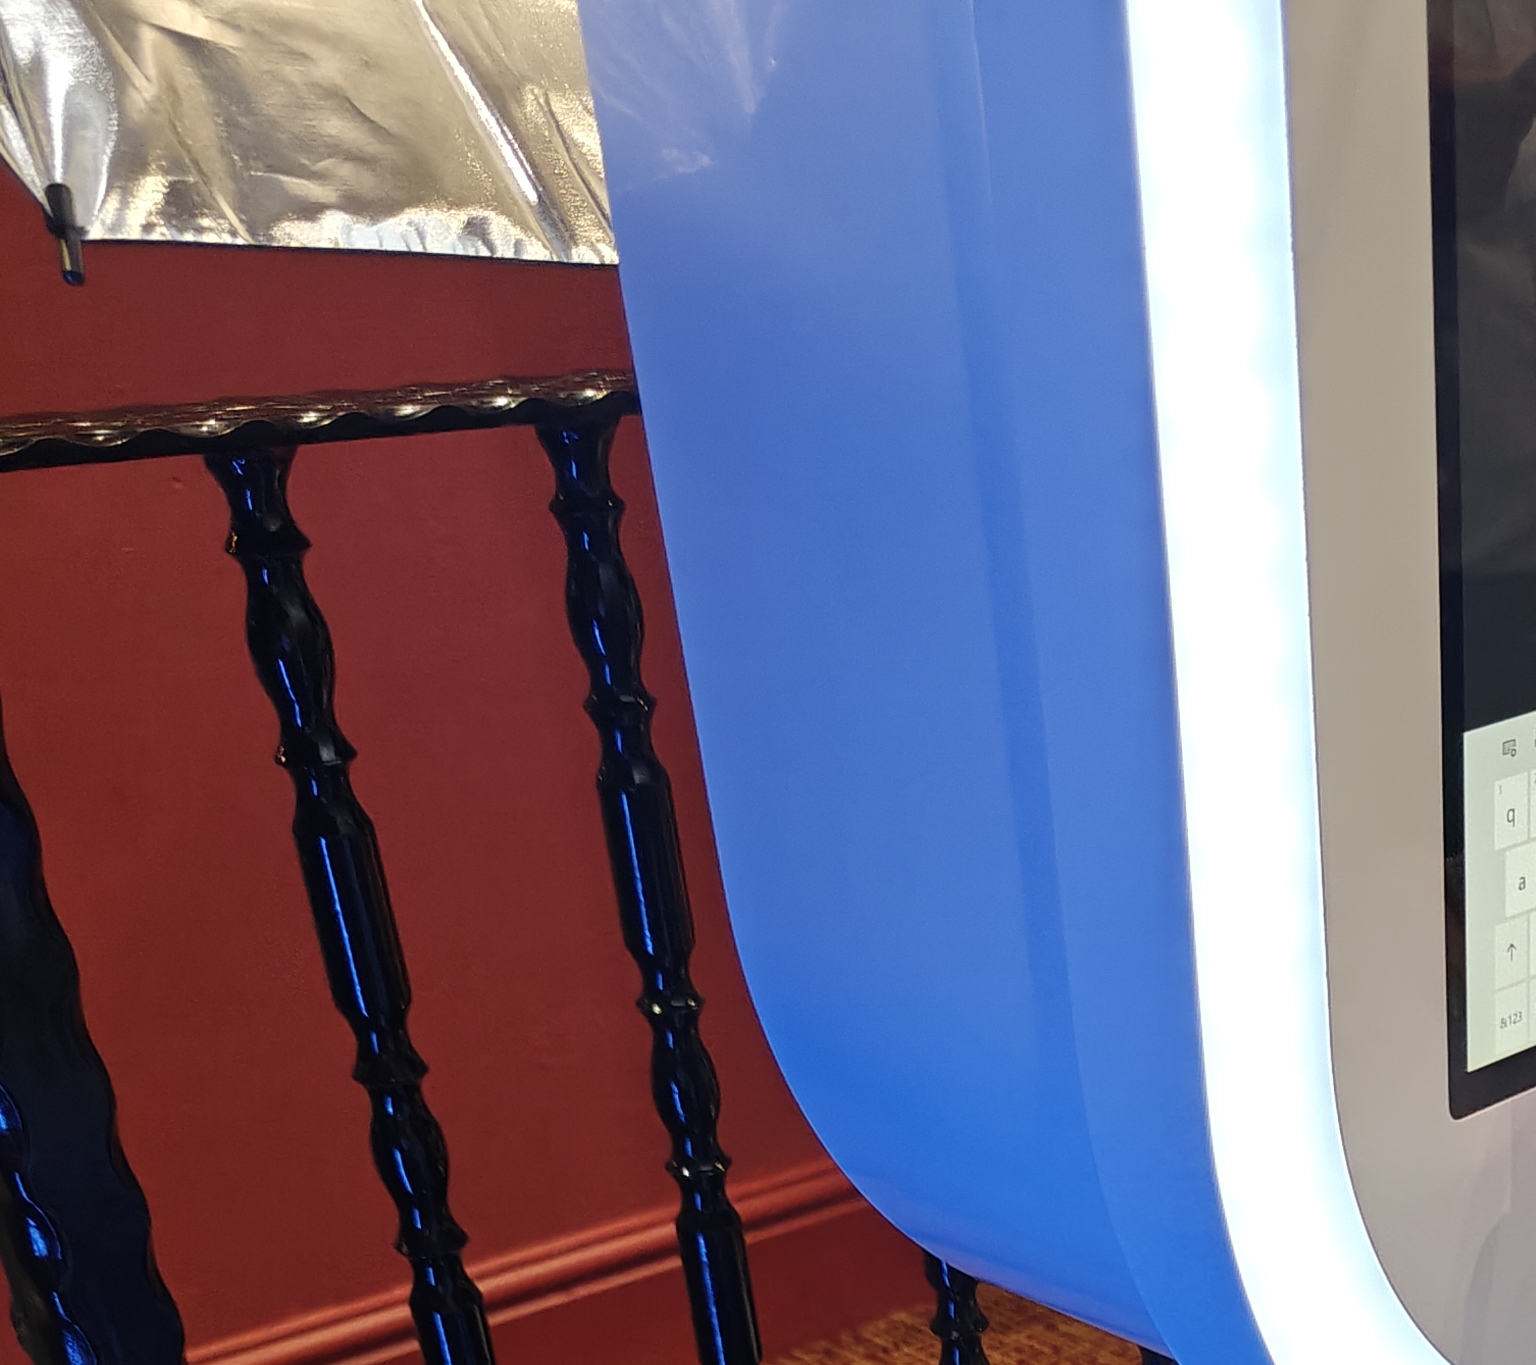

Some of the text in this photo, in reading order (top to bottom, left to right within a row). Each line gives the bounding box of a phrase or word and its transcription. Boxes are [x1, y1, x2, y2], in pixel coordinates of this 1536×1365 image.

[1506, 807, 1516, 828] q
[1518, 876, 1526, 891] a
[1500, 1011, 1522, 1029] &123
